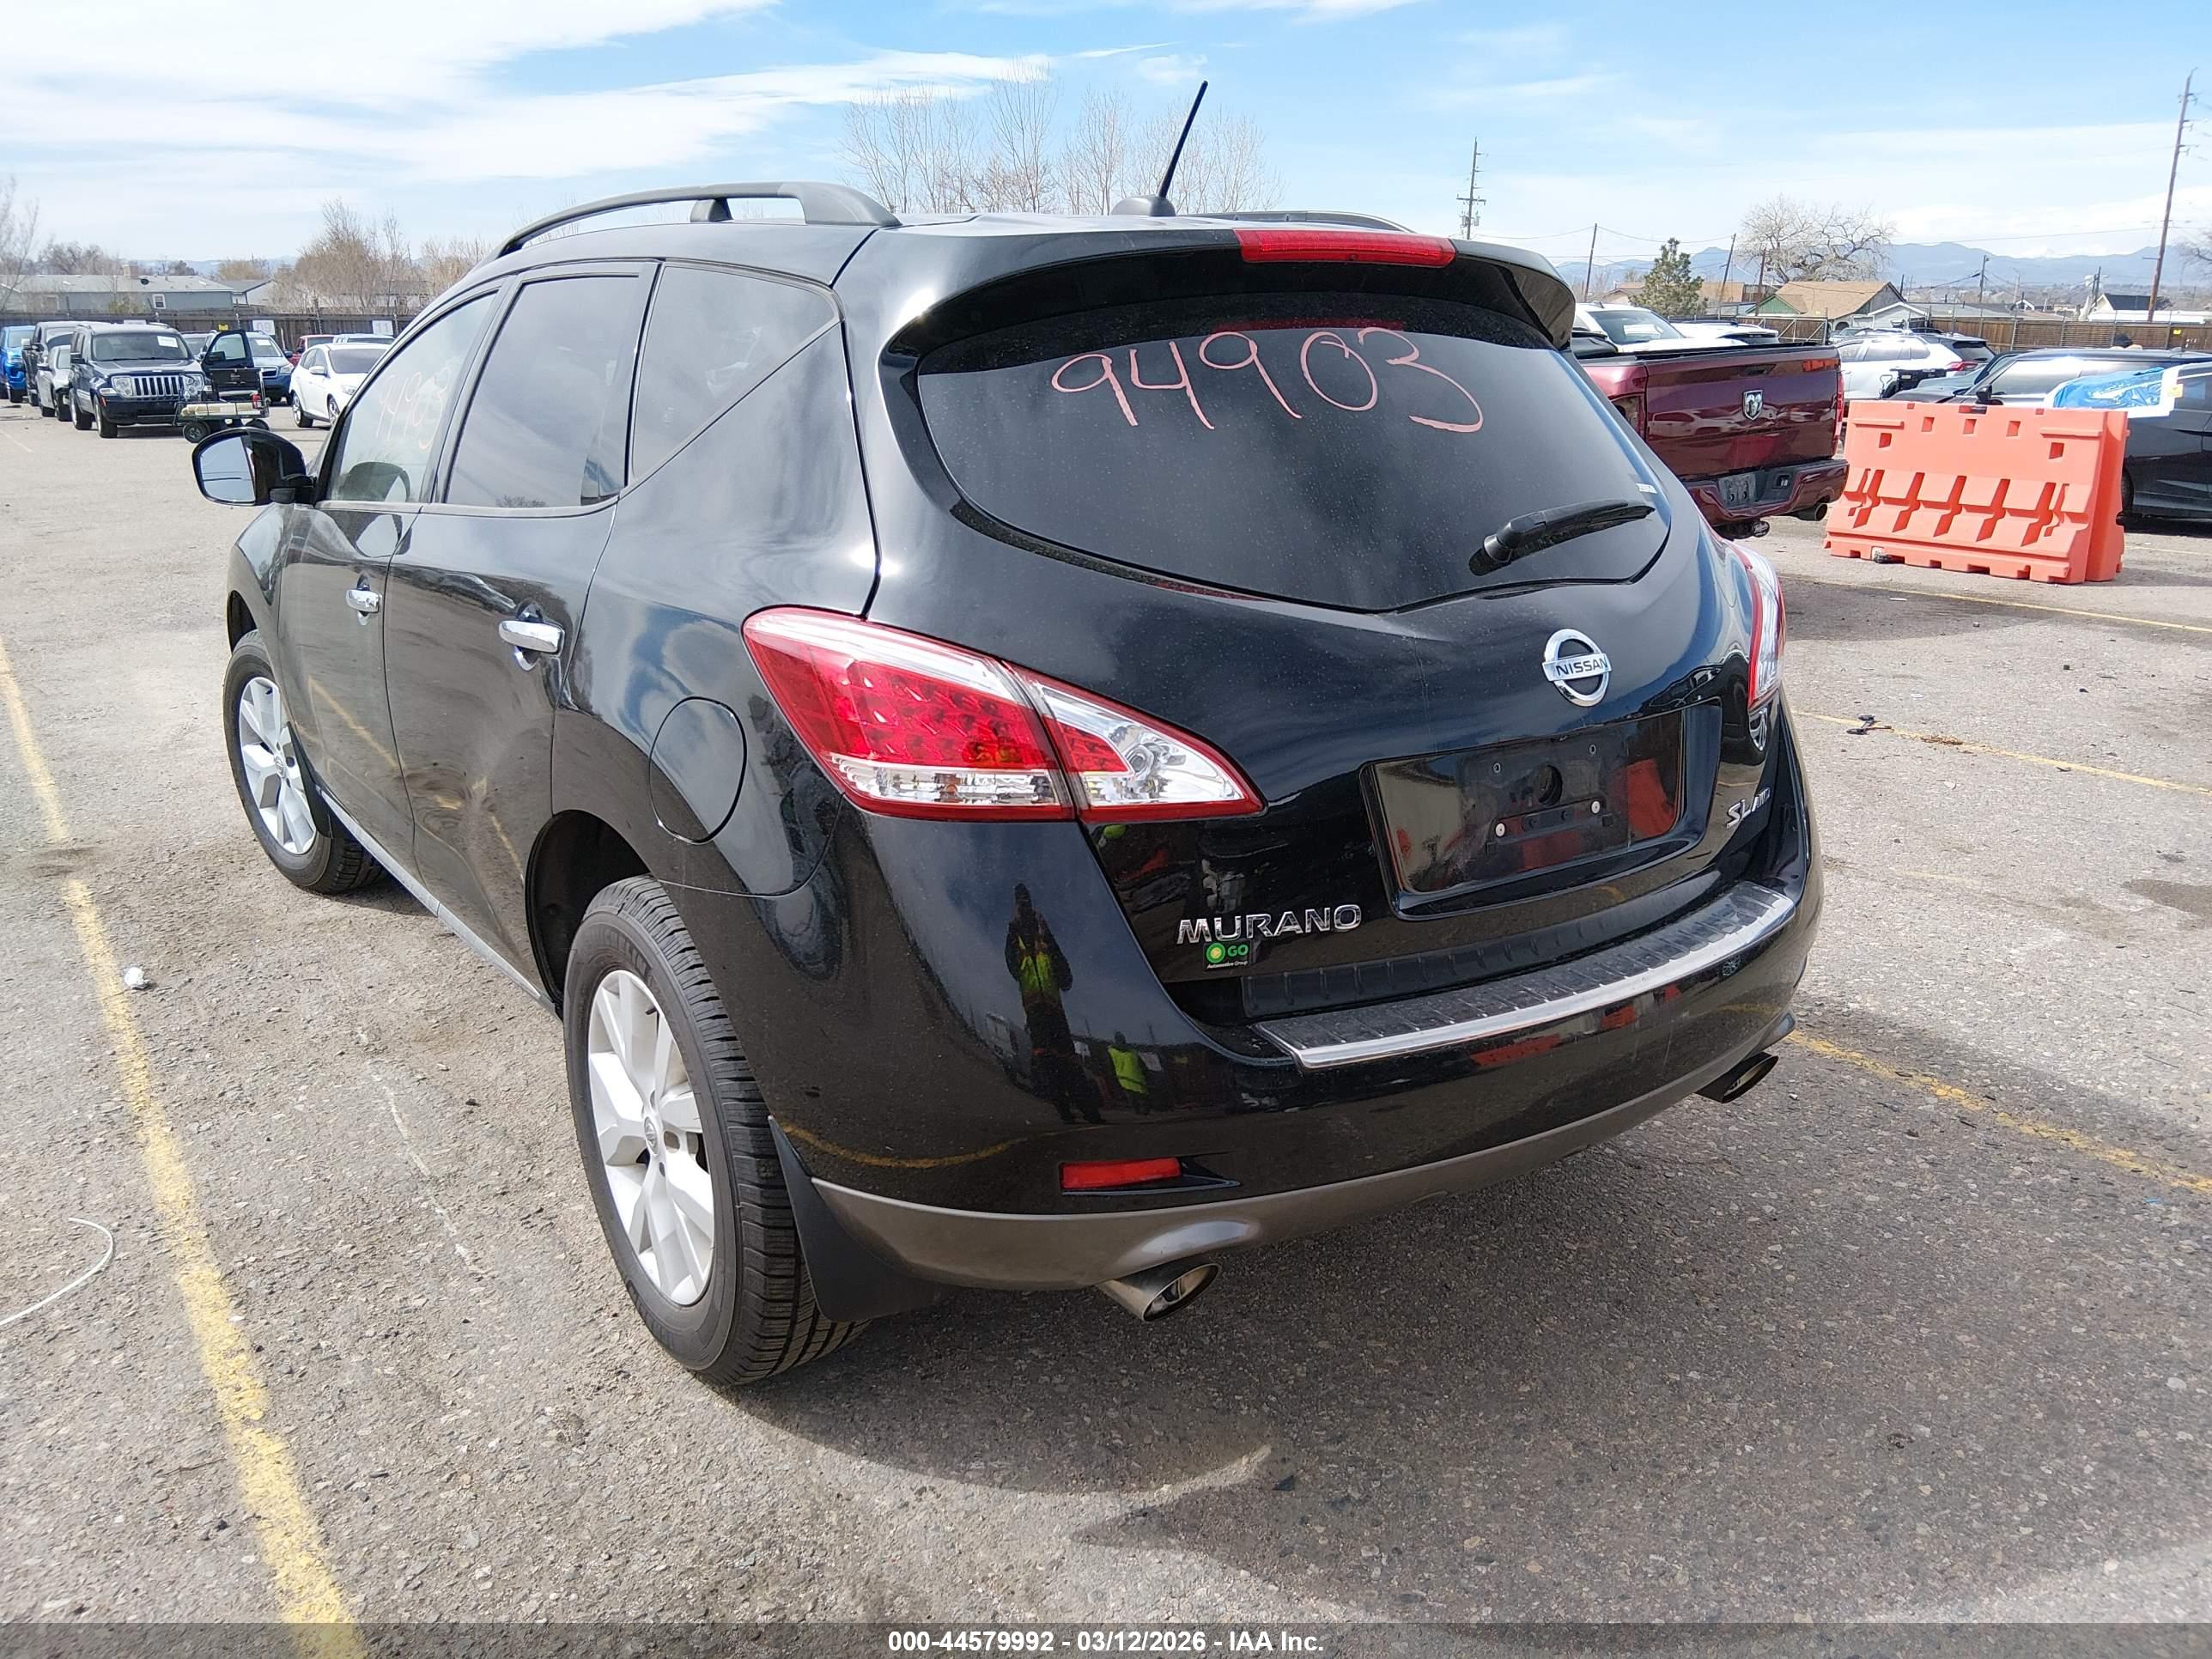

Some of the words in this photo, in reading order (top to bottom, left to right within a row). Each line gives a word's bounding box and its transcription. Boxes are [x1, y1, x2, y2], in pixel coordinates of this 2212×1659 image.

[1051, 327, 1484, 433] 94903
[1556, 657, 1608, 676] NISSAN
[1176, 904, 1362, 945] MURANO
[1228, 945, 1249, 957] GO
